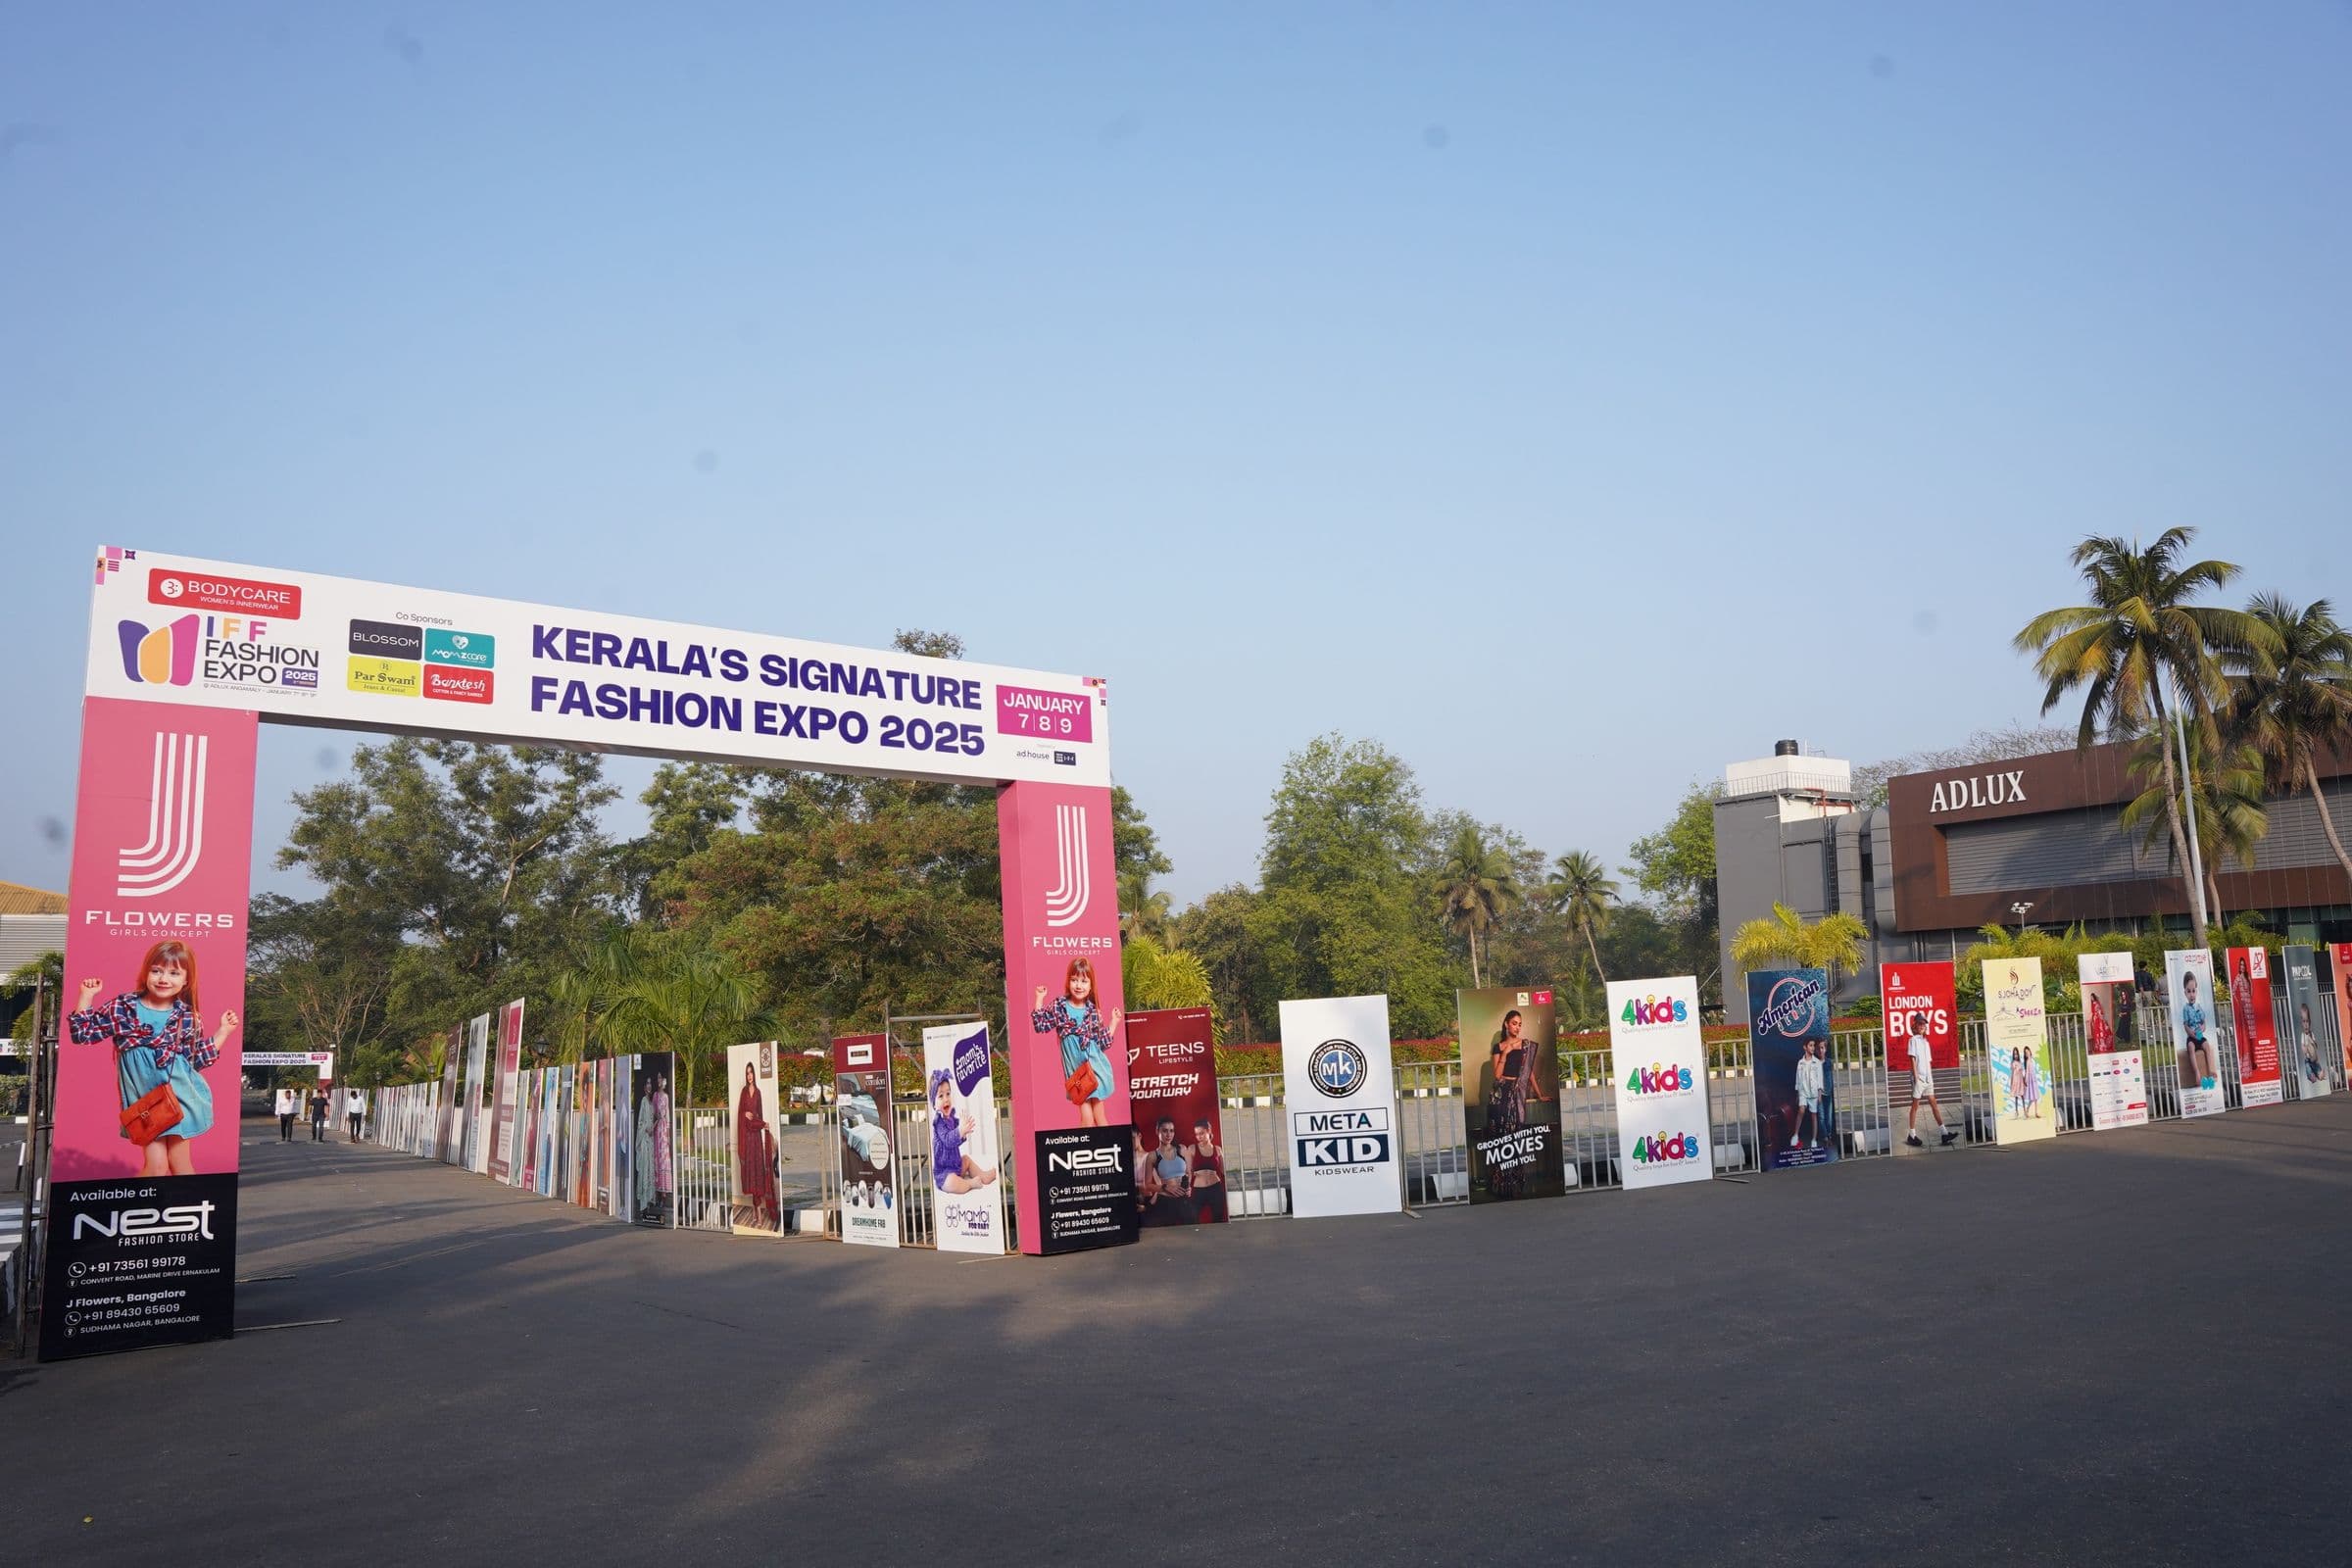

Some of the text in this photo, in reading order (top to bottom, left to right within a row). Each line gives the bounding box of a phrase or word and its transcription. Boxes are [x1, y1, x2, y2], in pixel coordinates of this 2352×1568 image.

[188, 580, 291, 605] BODYCARE
[200, 596, 278, 611] WOMEN'S INNERWEAR
[395, 612, 453, 626] Co Sponsors
[353, 632, 419, 648] BLOSSOM
[205, 639, 319, 667] FASHION
[204, 660, 317, 684] EXPO 2025
[354, 670, 375, 681] Par
[532, 624, 982, 710] KERALA'S SIGNATURE
[1004, 692, 1084, 715] JANUARY
[531, 675, 985, 757] FASHION EXPO 2025
[1930, 770, 2027, 812] ADLUX
[85, 909, 234, 928] FLOWERS
[110, 928, 212, 938] GIRLS CONCEPT
[1033, 936, 1113, 948] FLOWERS
[1621, 995, 1688, 1026] 4kids
[1758, 979, 1820, 1035] American
[1888, 995, 1934, 1009] LONDON
[1145, 1041, 1205, 1057] TEENS
[1130, 1073, 1200, 1090] STRETCH
[1626, 1062, 1693, 1095] 4kids
[1129, 1086, 1192, 1100] YOUR WAY
[1309, 1112, 1372, 1132] META
[1045, 1136, 1079, 1146] Available
[1477, 1134, 1512, 1151] GROOVES
[1513, 1128, 1533, 1140] WITH
[1632, 1130, 1699, 1163] 4kids
[1049, 1144, 1123, 1173] Nest
[1304, 1137, 1382, 1165] KID
[1486, 1135, 1544, 1165] MOVES
[1072, 1168, 1097, 1177] FASHION
[1314, 1166, 1375, 1176] KIDSWEAR
[1499, 1157, 1518, 1171] WITH
[70, 1187, 157, 1202] Available at:
[1059, 1186, 1071, 1195] +91
[1071, 1185, 1091, 1195] 73561
[1081, 1206, 1112, 1216] Bangalore
[73, 1200, 216, 1241] Nest
[1071, 1219, 1091, 1228] 89430
[118, 1232, 200, 1247] FASHION STORE
[88, 1256, 186, 1273] +91 73561 99178
[80, 1276, 114, 1286] CONVENT
[182, 1267, 220, 1276] ERNAKULAM
[66, 1289, 186, 1308] J Flowers, Bangalore
[83, 1303, 180, 1321] +91 89430 65609
[80, 1323, 122, 1334] SUDHAMA
[154, 1315, 200, 1326] BANGALORE
